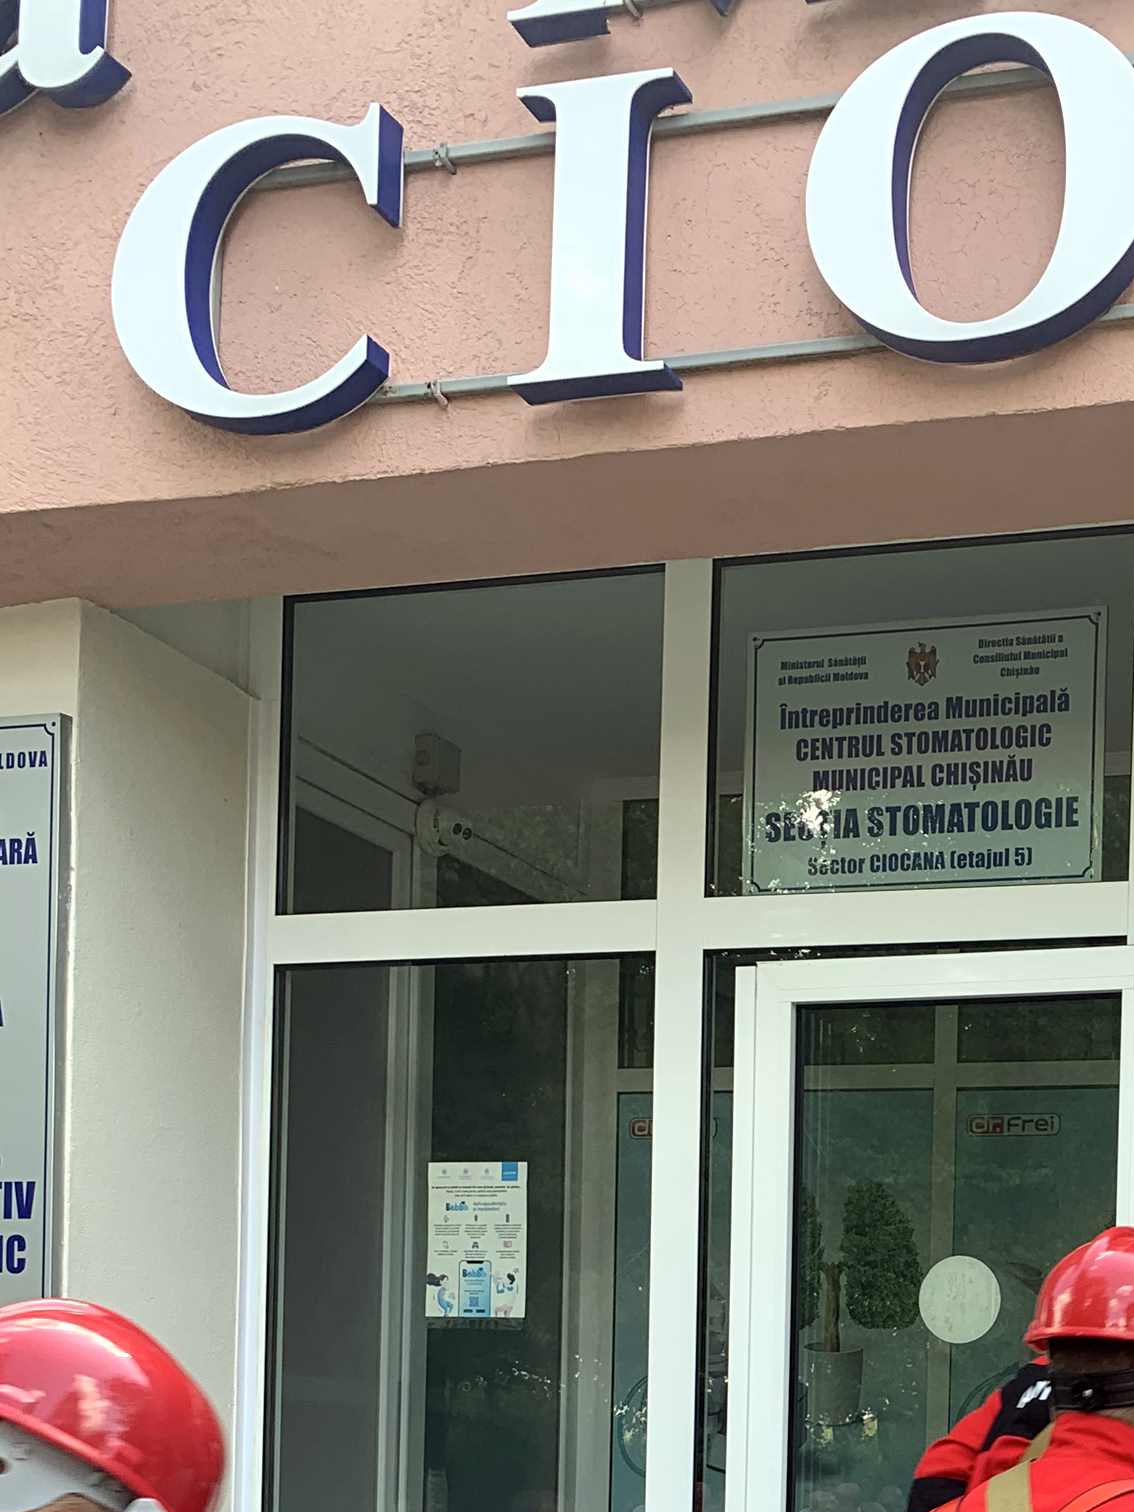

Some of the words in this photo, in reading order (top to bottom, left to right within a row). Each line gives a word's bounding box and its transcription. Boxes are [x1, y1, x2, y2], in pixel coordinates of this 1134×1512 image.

[780, 659, 825, 671] Ministerul
[1023, 648, 1069, 660] Municipal
[787, 672, 831, 685] Republicii
[832, 671, 869, 682] Moldova
[778, 701, 939, 730] Întreprinderea
[945, 688, 1071, 719] Municipală
[795, 734, 885, 762] CENTRUL
[890, 723, 1053, 756] STOMATOLOGIC
[812, 765, 926, 793] MUNICIPAL
[931, 755, 1034, 791] CHIȘINĂU
[867, 796, 1080, 838] STOMATOLOGIE
[808, 857, 866, 876] Sector
[869, 851, 946, 873] CIOCANA
[950, 848, 1010, 870] (etajul
[1013, 847, 1033, 866] 5)
[0, 1181, 36, 1219] IV
